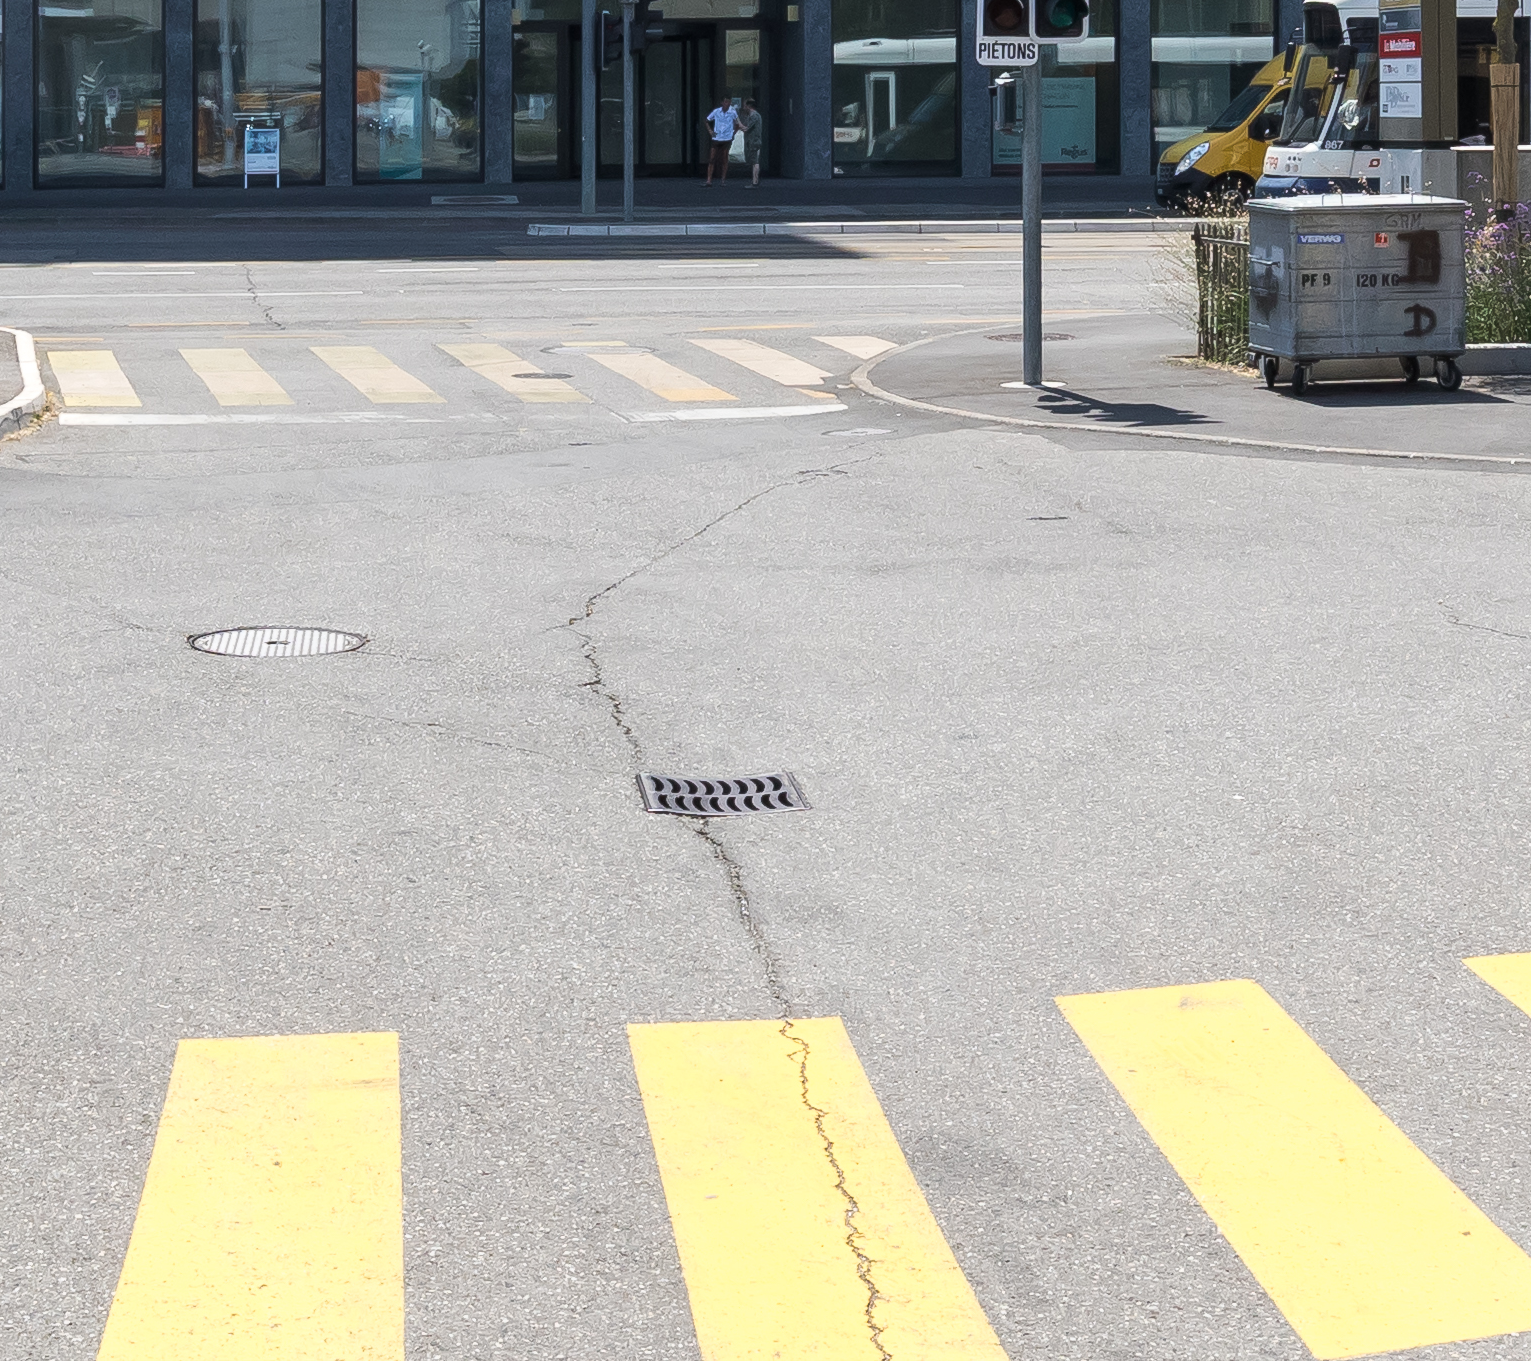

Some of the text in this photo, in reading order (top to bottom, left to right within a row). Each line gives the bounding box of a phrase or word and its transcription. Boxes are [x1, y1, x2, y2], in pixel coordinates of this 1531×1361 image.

[978, 40, 1036, 60] PIÉTONS
[1301, 273, 1332, 290] PF 9
[1356, 273, 1378, 287] 120
